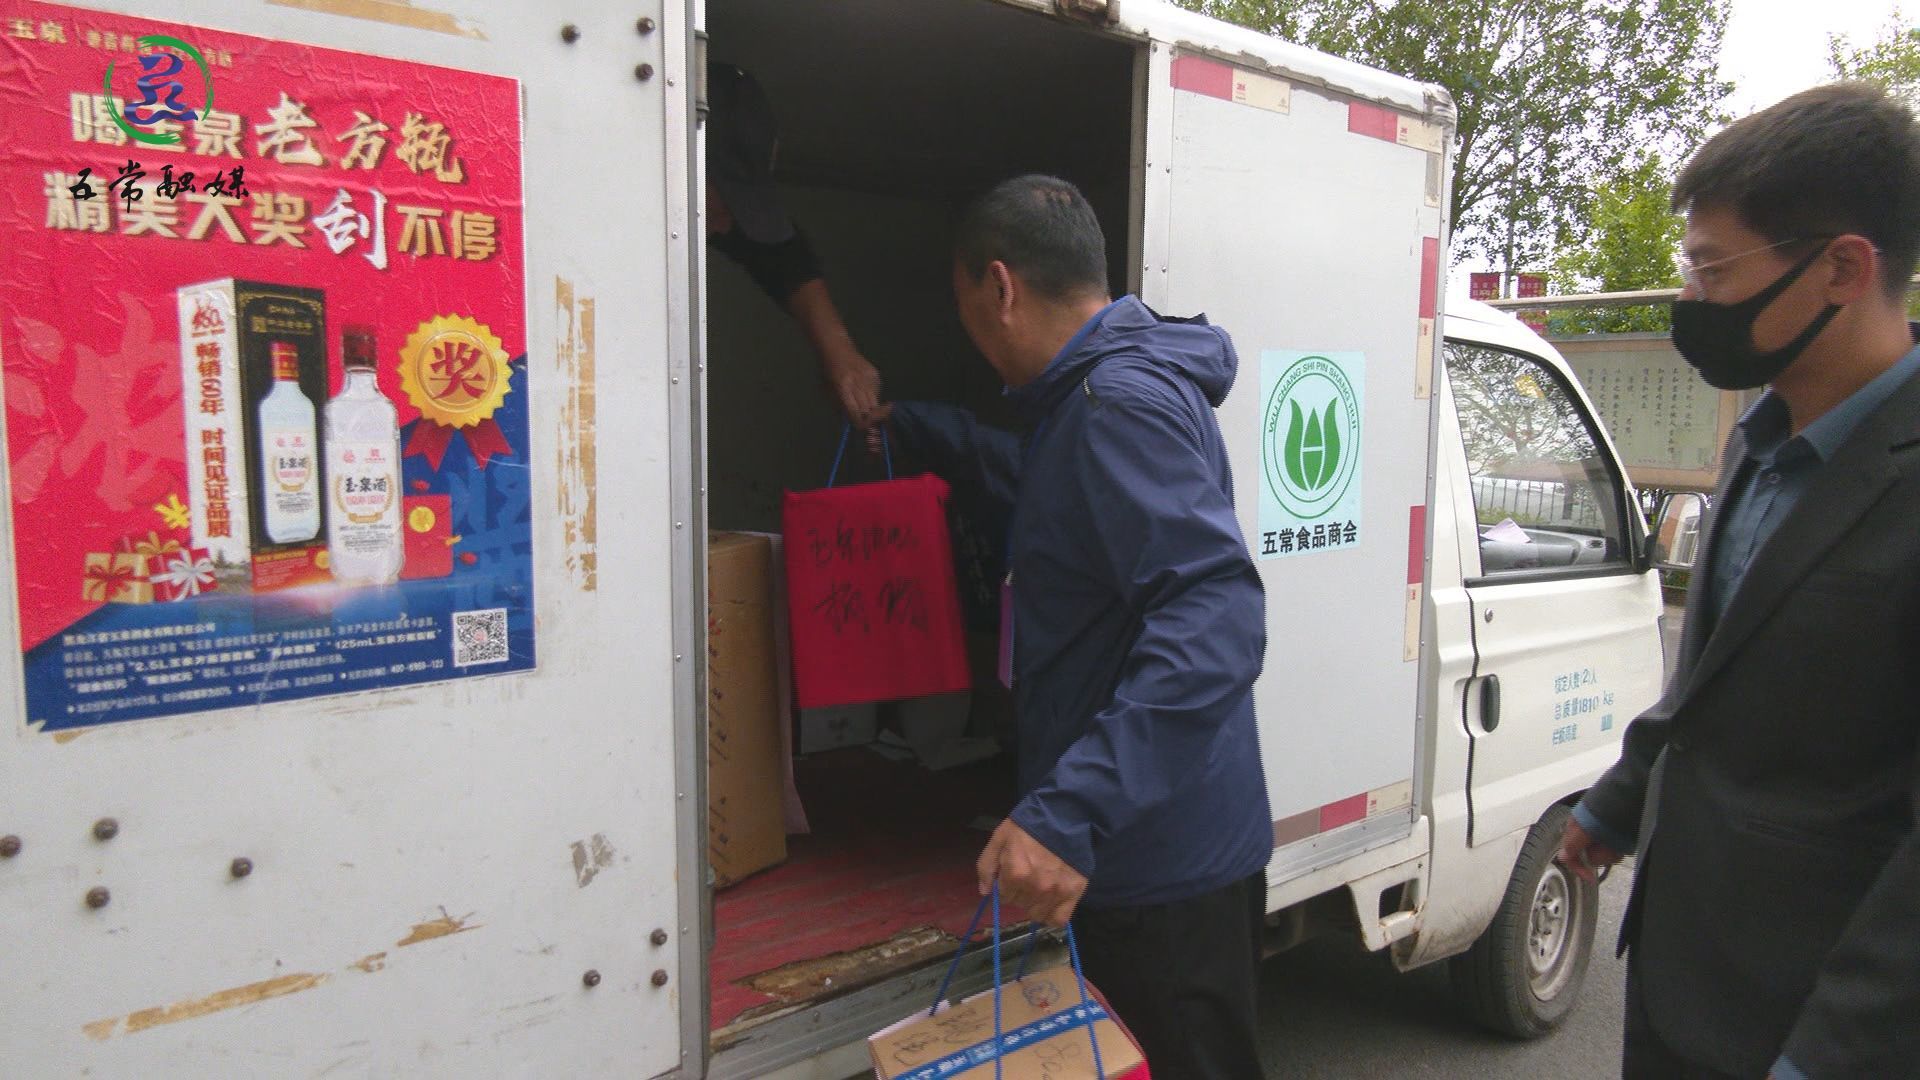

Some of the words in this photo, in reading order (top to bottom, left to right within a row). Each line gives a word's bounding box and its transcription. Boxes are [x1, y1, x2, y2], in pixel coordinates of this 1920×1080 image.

[429, 341, 488, 400] 奖
[1277, 367, 1301, 403] CHANG
[1302, 361, 1315, 373] SHI
[1316, 361, 1329, 372] PIN
[1262, 519, 1357, 555] 五常食品商会
